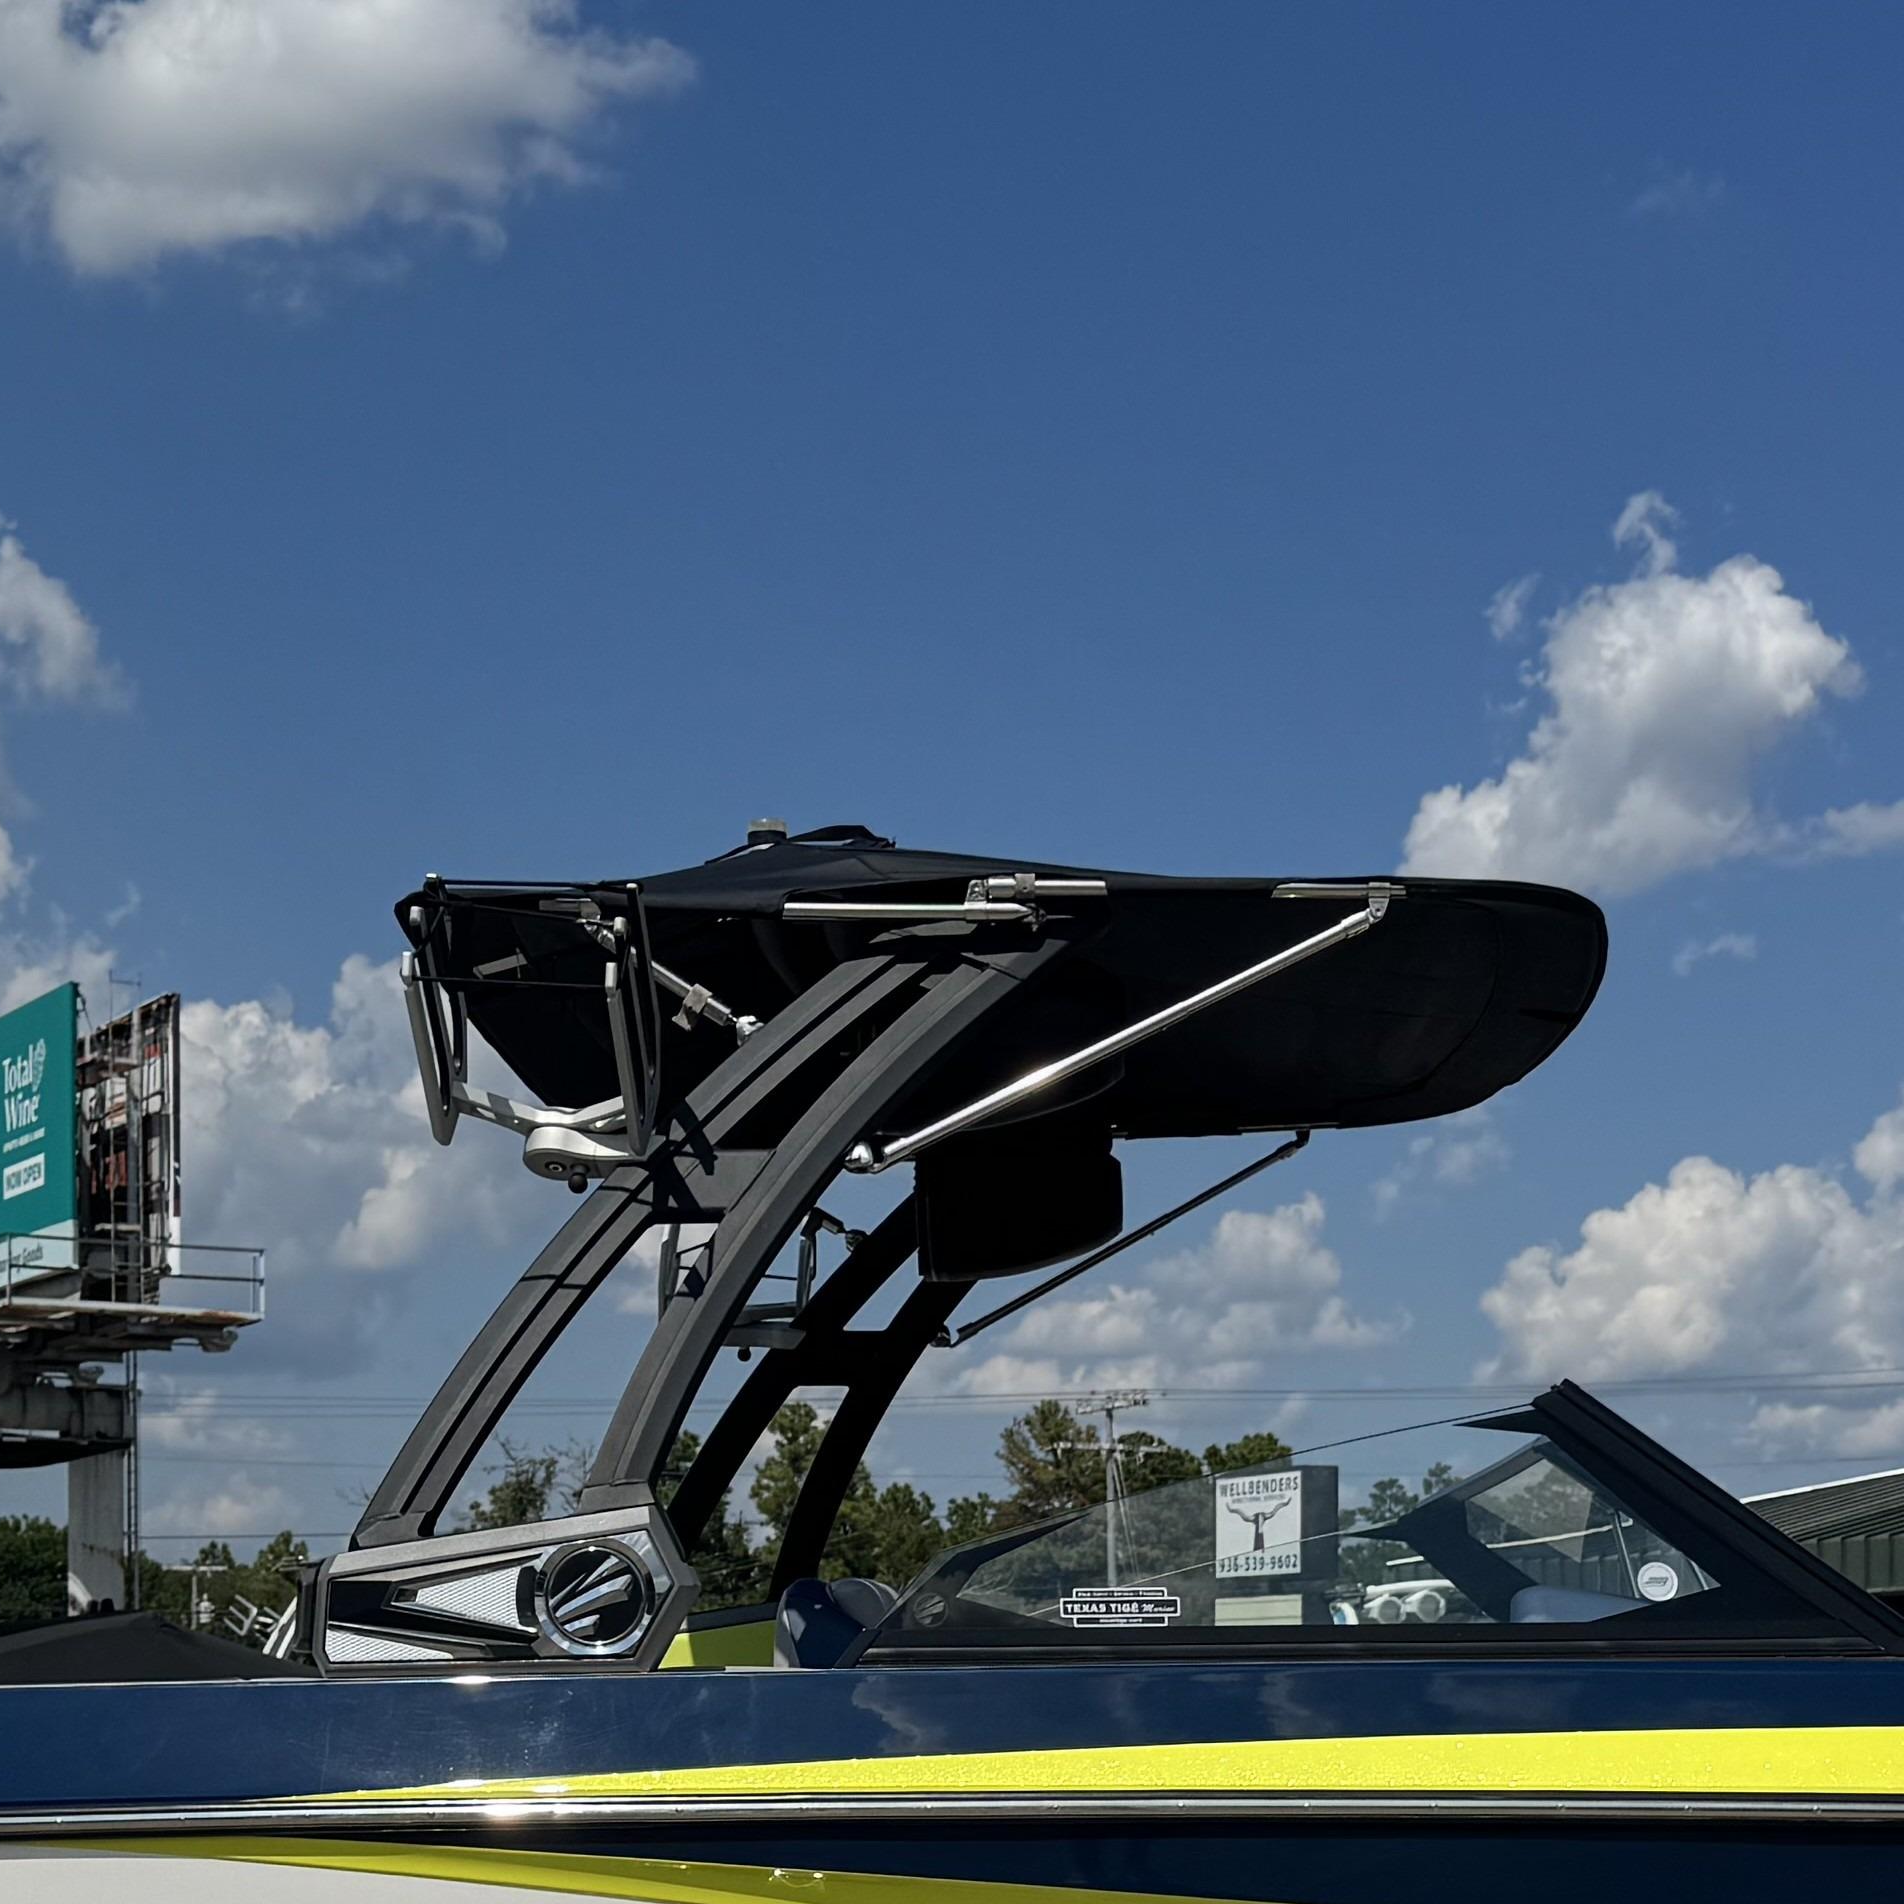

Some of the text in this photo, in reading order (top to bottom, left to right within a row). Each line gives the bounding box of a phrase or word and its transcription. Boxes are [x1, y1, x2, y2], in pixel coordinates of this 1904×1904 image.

[1, 1043, 34, 1095] Total
[4, 1092, 40, 1133] Wine
[1219, 1476, 1299, 1497] WELLBENDERS
[1219, 1553, 1299, 1573] 936-539-9602
[1065, 1603, 1106, 1614] TEXAS
